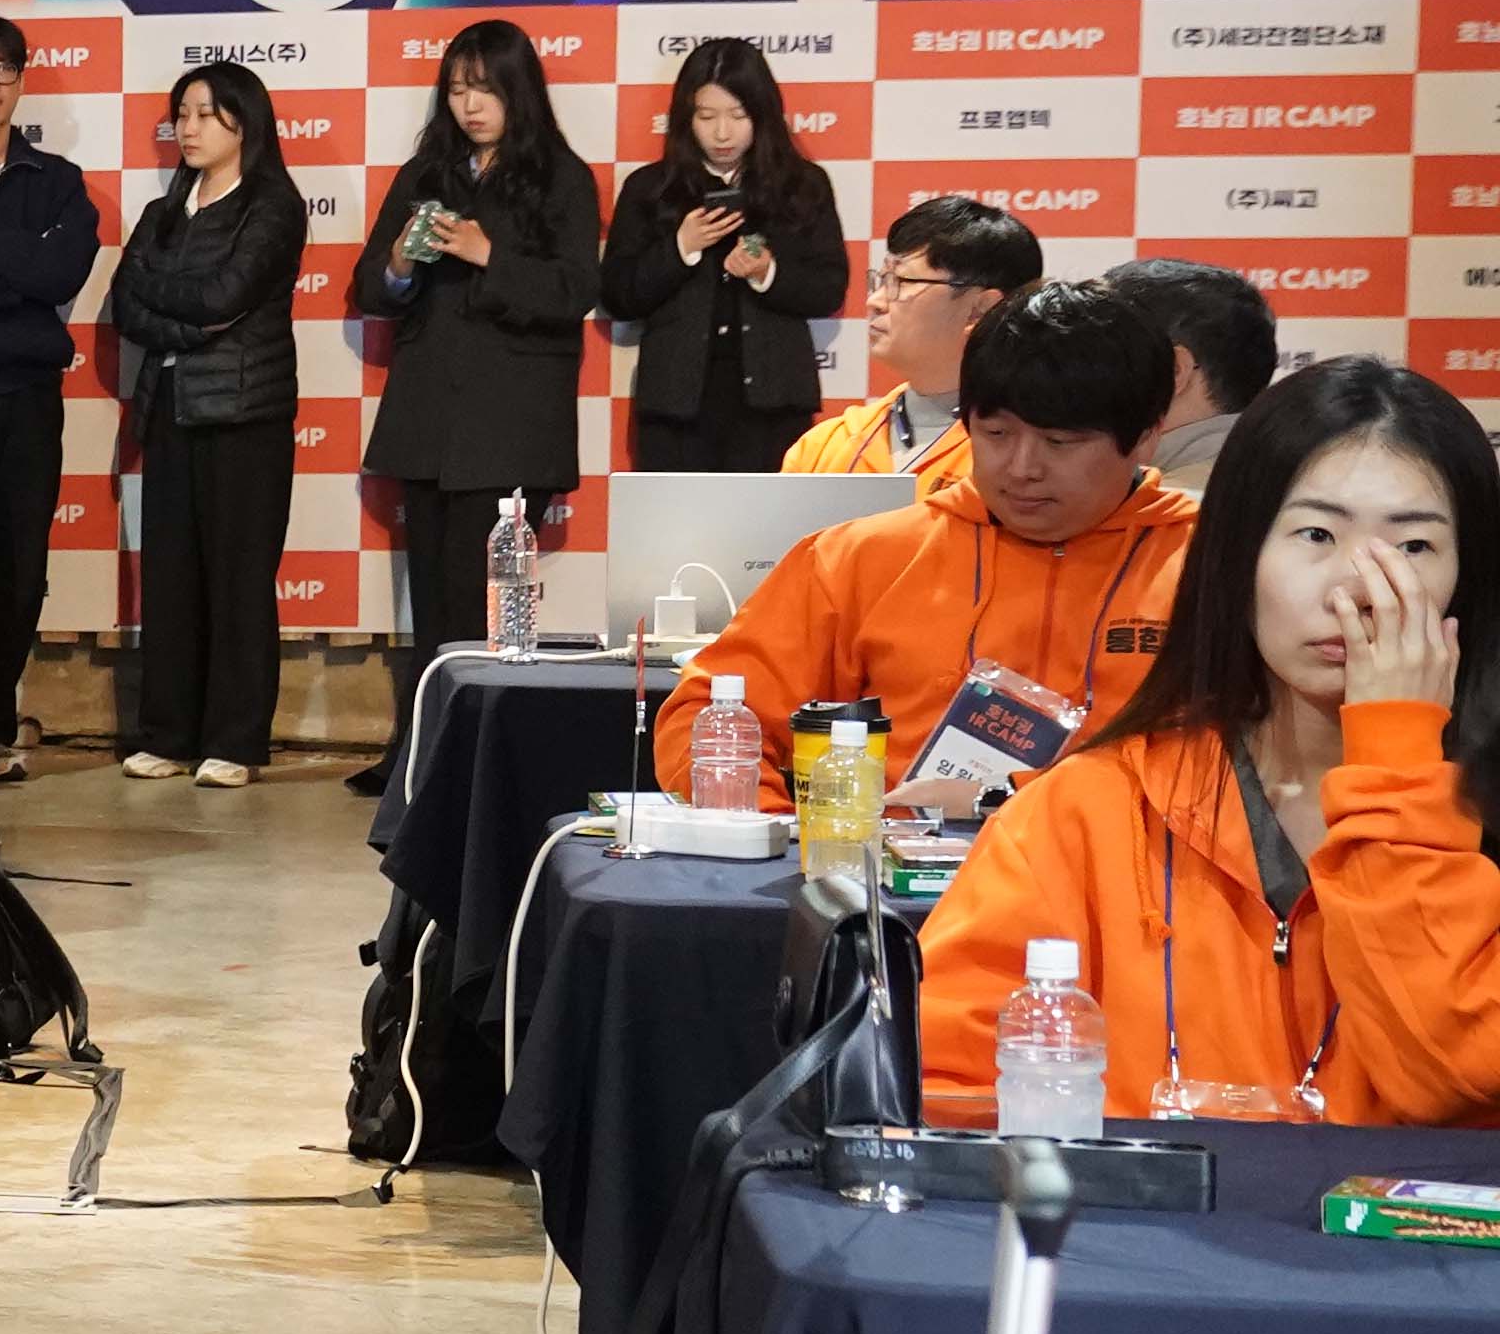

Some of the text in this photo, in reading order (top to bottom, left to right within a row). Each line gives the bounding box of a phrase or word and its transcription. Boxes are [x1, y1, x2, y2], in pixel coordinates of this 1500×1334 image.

[402, 39, 457, 61] 호남
[536, 35, 583, 58] MP
[912, 27, 1105, 53] 호남권 IR CAMP
[24, 46, 90, 70] AMP
[182, 41, 307, 67] 트래시스(주)
[1176, 104, 1377, 129] 호남권 IR CAMP
[276, 118, 331, 141] AMP
[1013, 188, 1100, 212] CAMP
[1280, 268, 1370, 291] CAMP
[987, 722, 1037, 751] CAMP
